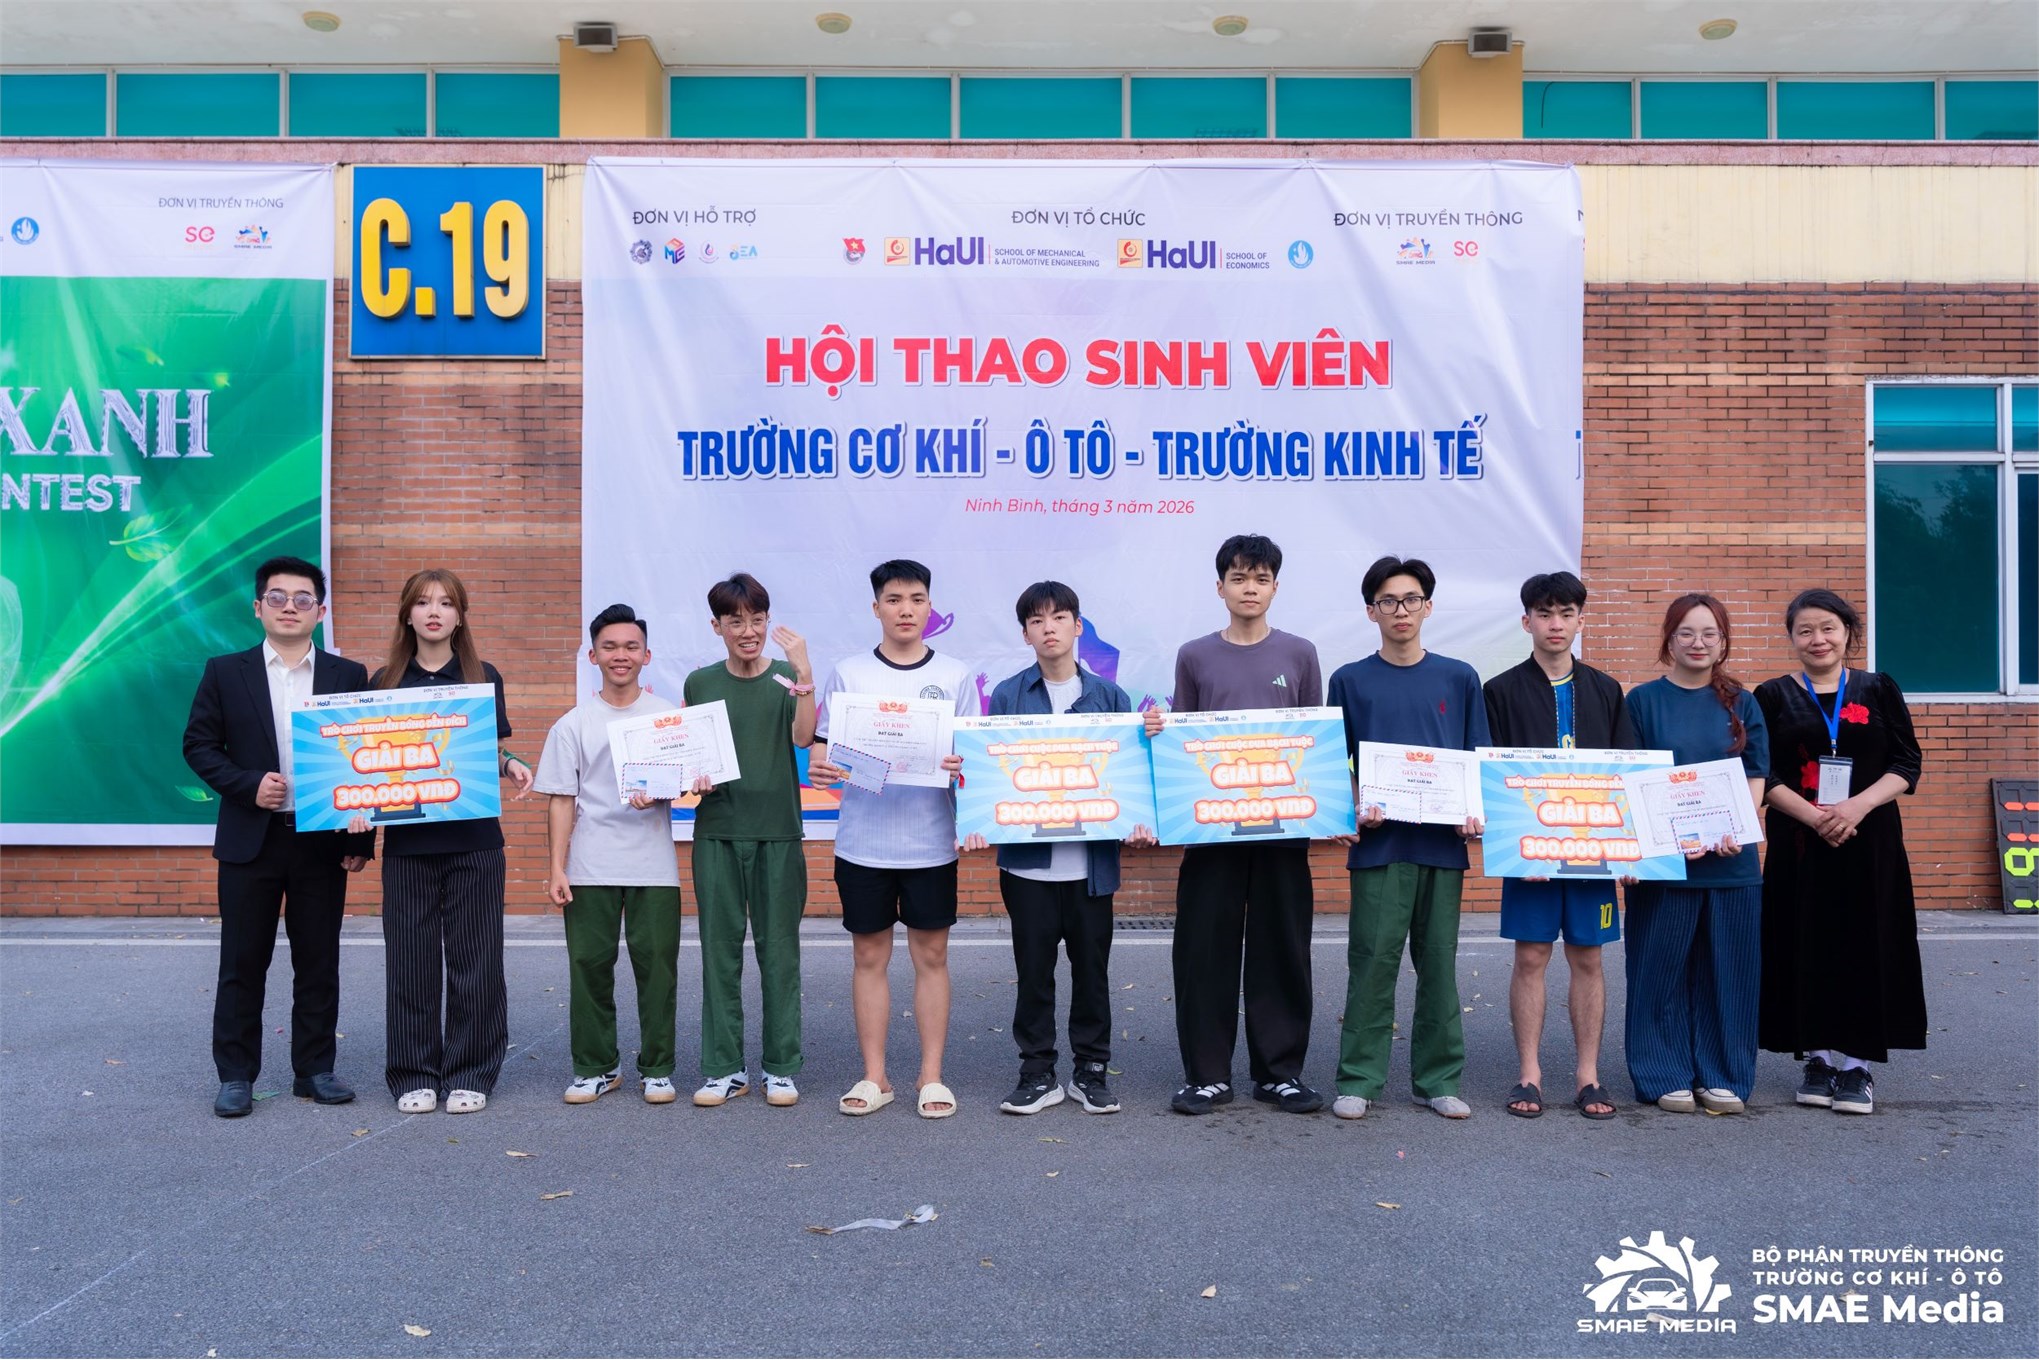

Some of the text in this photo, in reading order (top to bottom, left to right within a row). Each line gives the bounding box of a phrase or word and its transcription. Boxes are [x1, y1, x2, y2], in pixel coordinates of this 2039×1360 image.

[632, 205, 756, 227] ĐƠN VỊ HỖ TRỢ
[1011, 206, 1146, 228] ĐƠN VỊ TỔ CHỨC
[1334, 208, 1523, 229] ĐƠN VỊ TRUYỀN THÔNG
[360, 198, 530, 319] C.19
[994, 248, 1086, 258] SCHOOL OF MECHANICAL
[1002, 258, 1049, 267] AUTOMOTIVE
[1051, 259, 1100, 267] ENGINEERING
[1226, 252, 1255, 260] SCHOOL
[766, 324, 1390, 397] HỘI THAO SINH VIÊN
[0, 386, 214, 459] XANH
[678, 413, 1487, 477] TRƯỜNG CƠ KHÍ - Ô TÔ - TRƯỜNG KINH TẾ
[965, 497, 1195, 517] Ninh Bình, tháng 3 năm 2026
[355, 742, 437, 770] GIẢI BA
[1016, 763, 1096, 788] GIẢI BA
[1213, 759, 1292, 786] GIẢI BA
[337, 783, 416, 807] 300.000
[998, 803, 1076, 823] 300.000
[1197, 801, 1274, 821] 300.000
[1540, 798, 1620, 825] GIẢI BA
[1523, 838, 1602, 858] 300.000
[1600, 903, 1613, 930] 10
